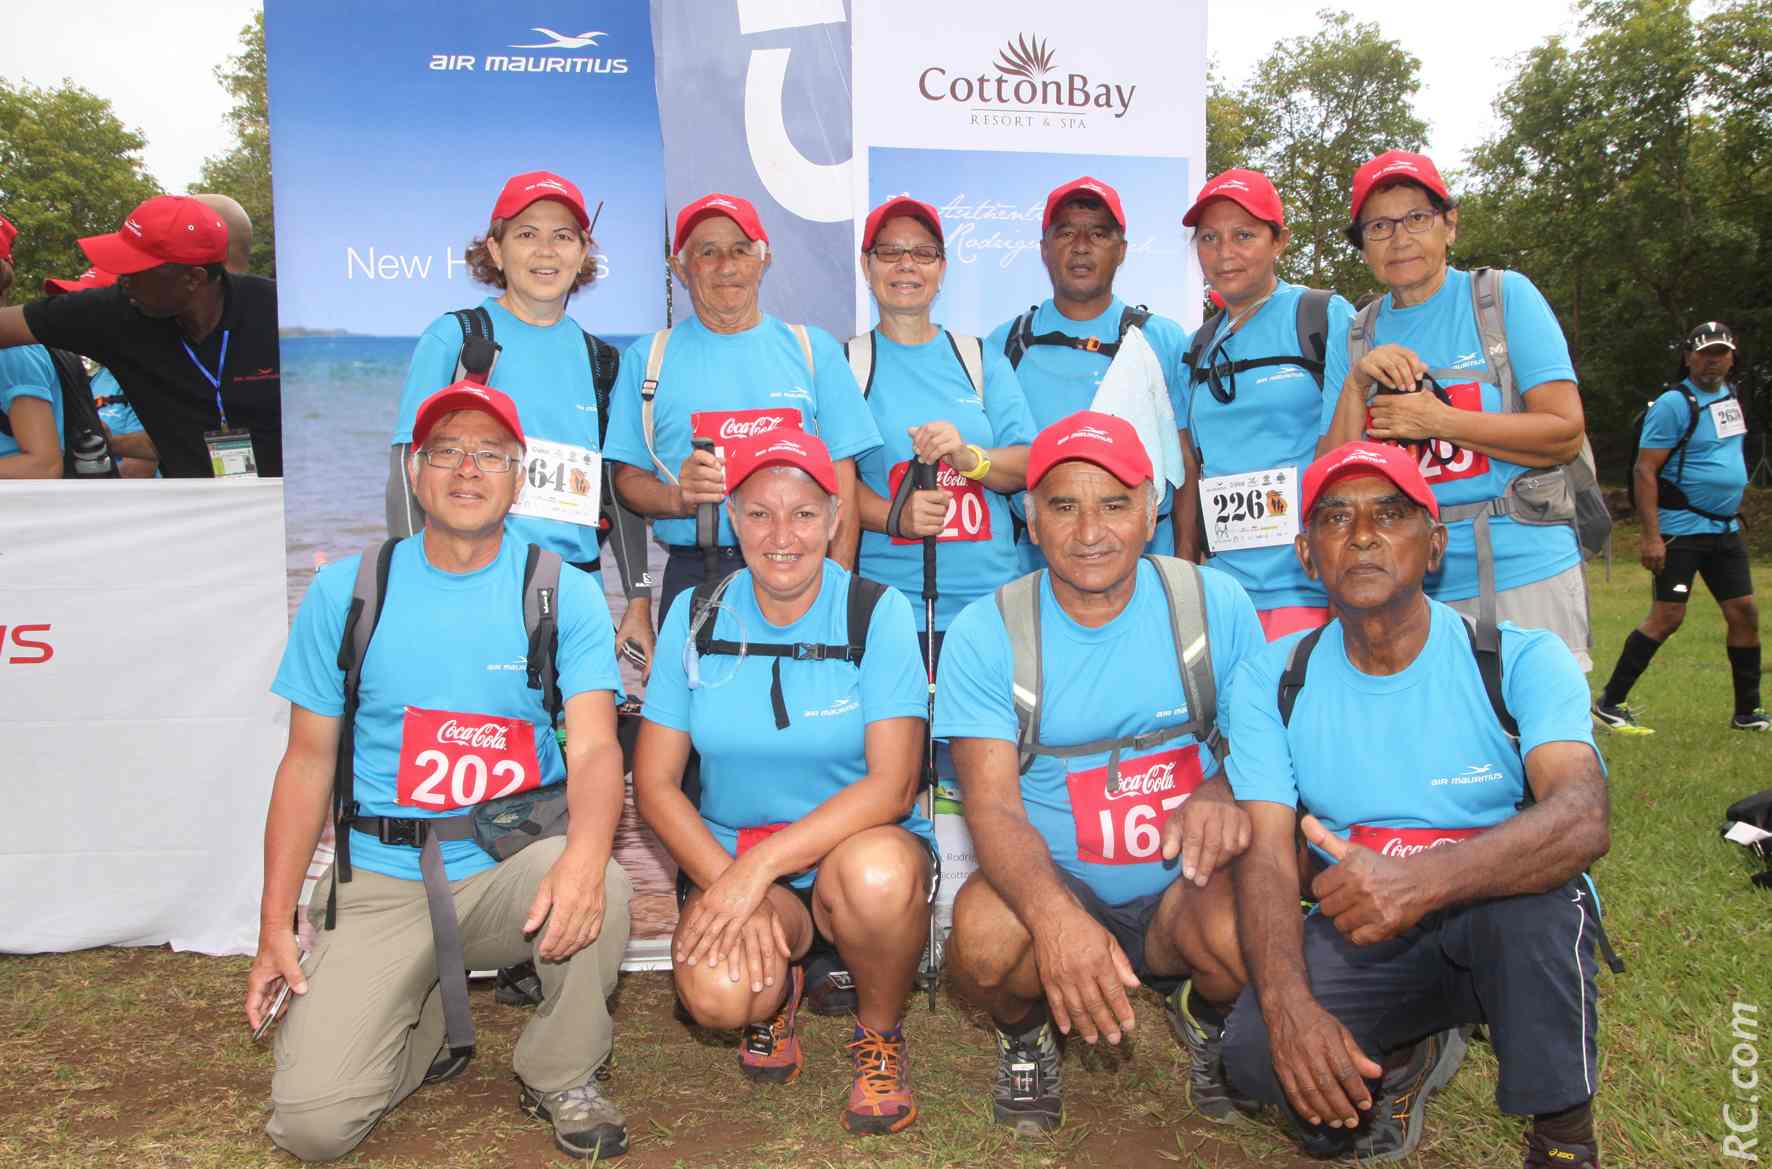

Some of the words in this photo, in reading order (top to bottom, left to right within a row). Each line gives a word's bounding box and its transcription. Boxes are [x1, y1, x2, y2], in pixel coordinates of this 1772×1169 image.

[970, 113, 1034, 127] RESORT
[1060, 117, 1087, 128] SPA
[346, 248, 432, 281] New
[720, 417, 784, 440] Coca-C
[1213, 489, 1265, 524] 226
[437, 719, 509, 751] Coca-Cola
[411, 749, 526, 806] 202
[1104, 761, 1176, 801] ca-Cola
